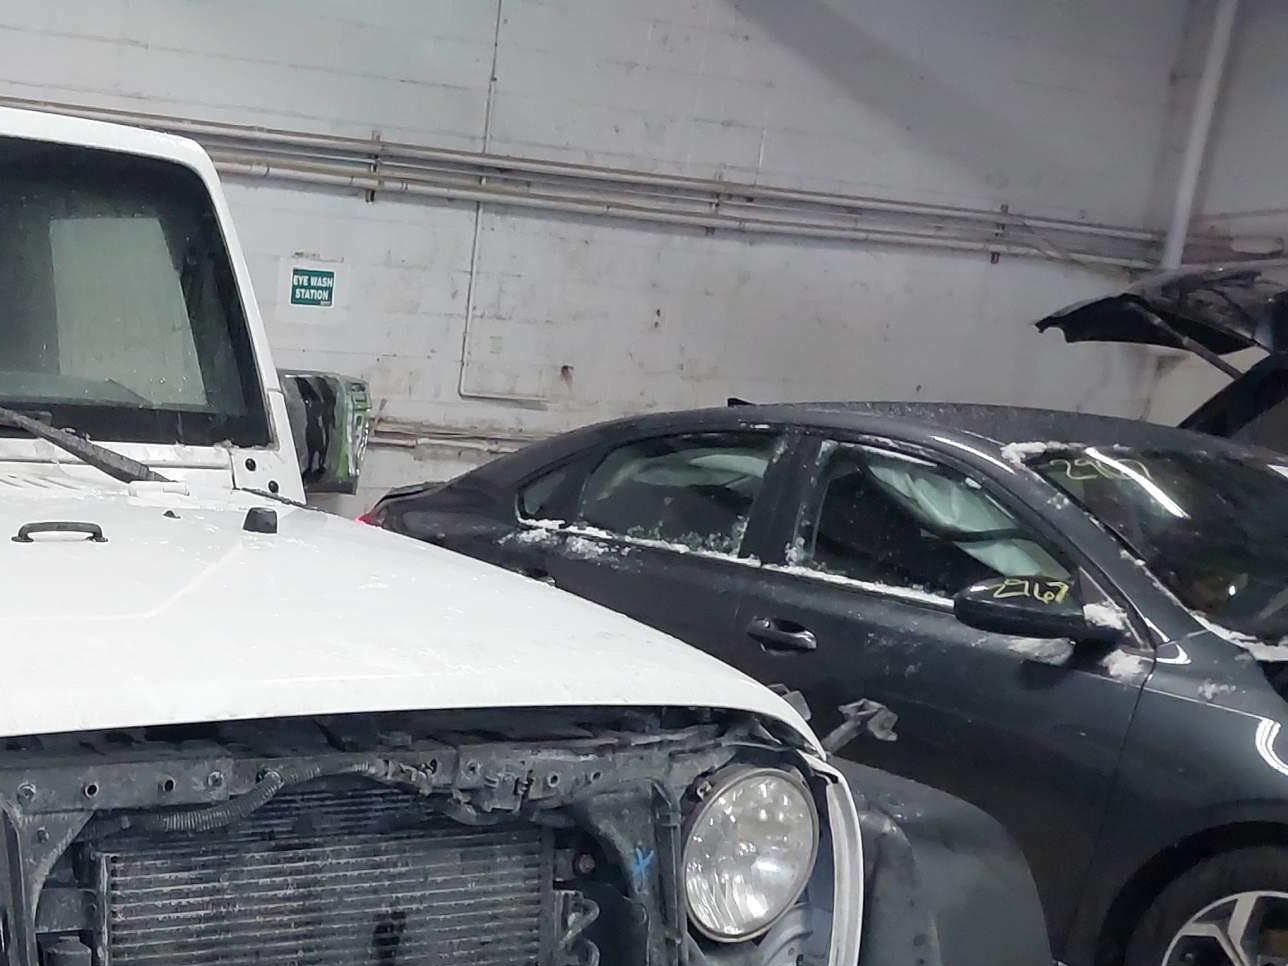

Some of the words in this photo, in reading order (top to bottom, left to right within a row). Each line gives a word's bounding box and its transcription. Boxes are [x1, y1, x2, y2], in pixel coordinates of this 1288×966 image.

[293, 275, 309, 286] EYE
[310, 275, 333, 288] WASH
[295, 288, 329, 300] STATION
